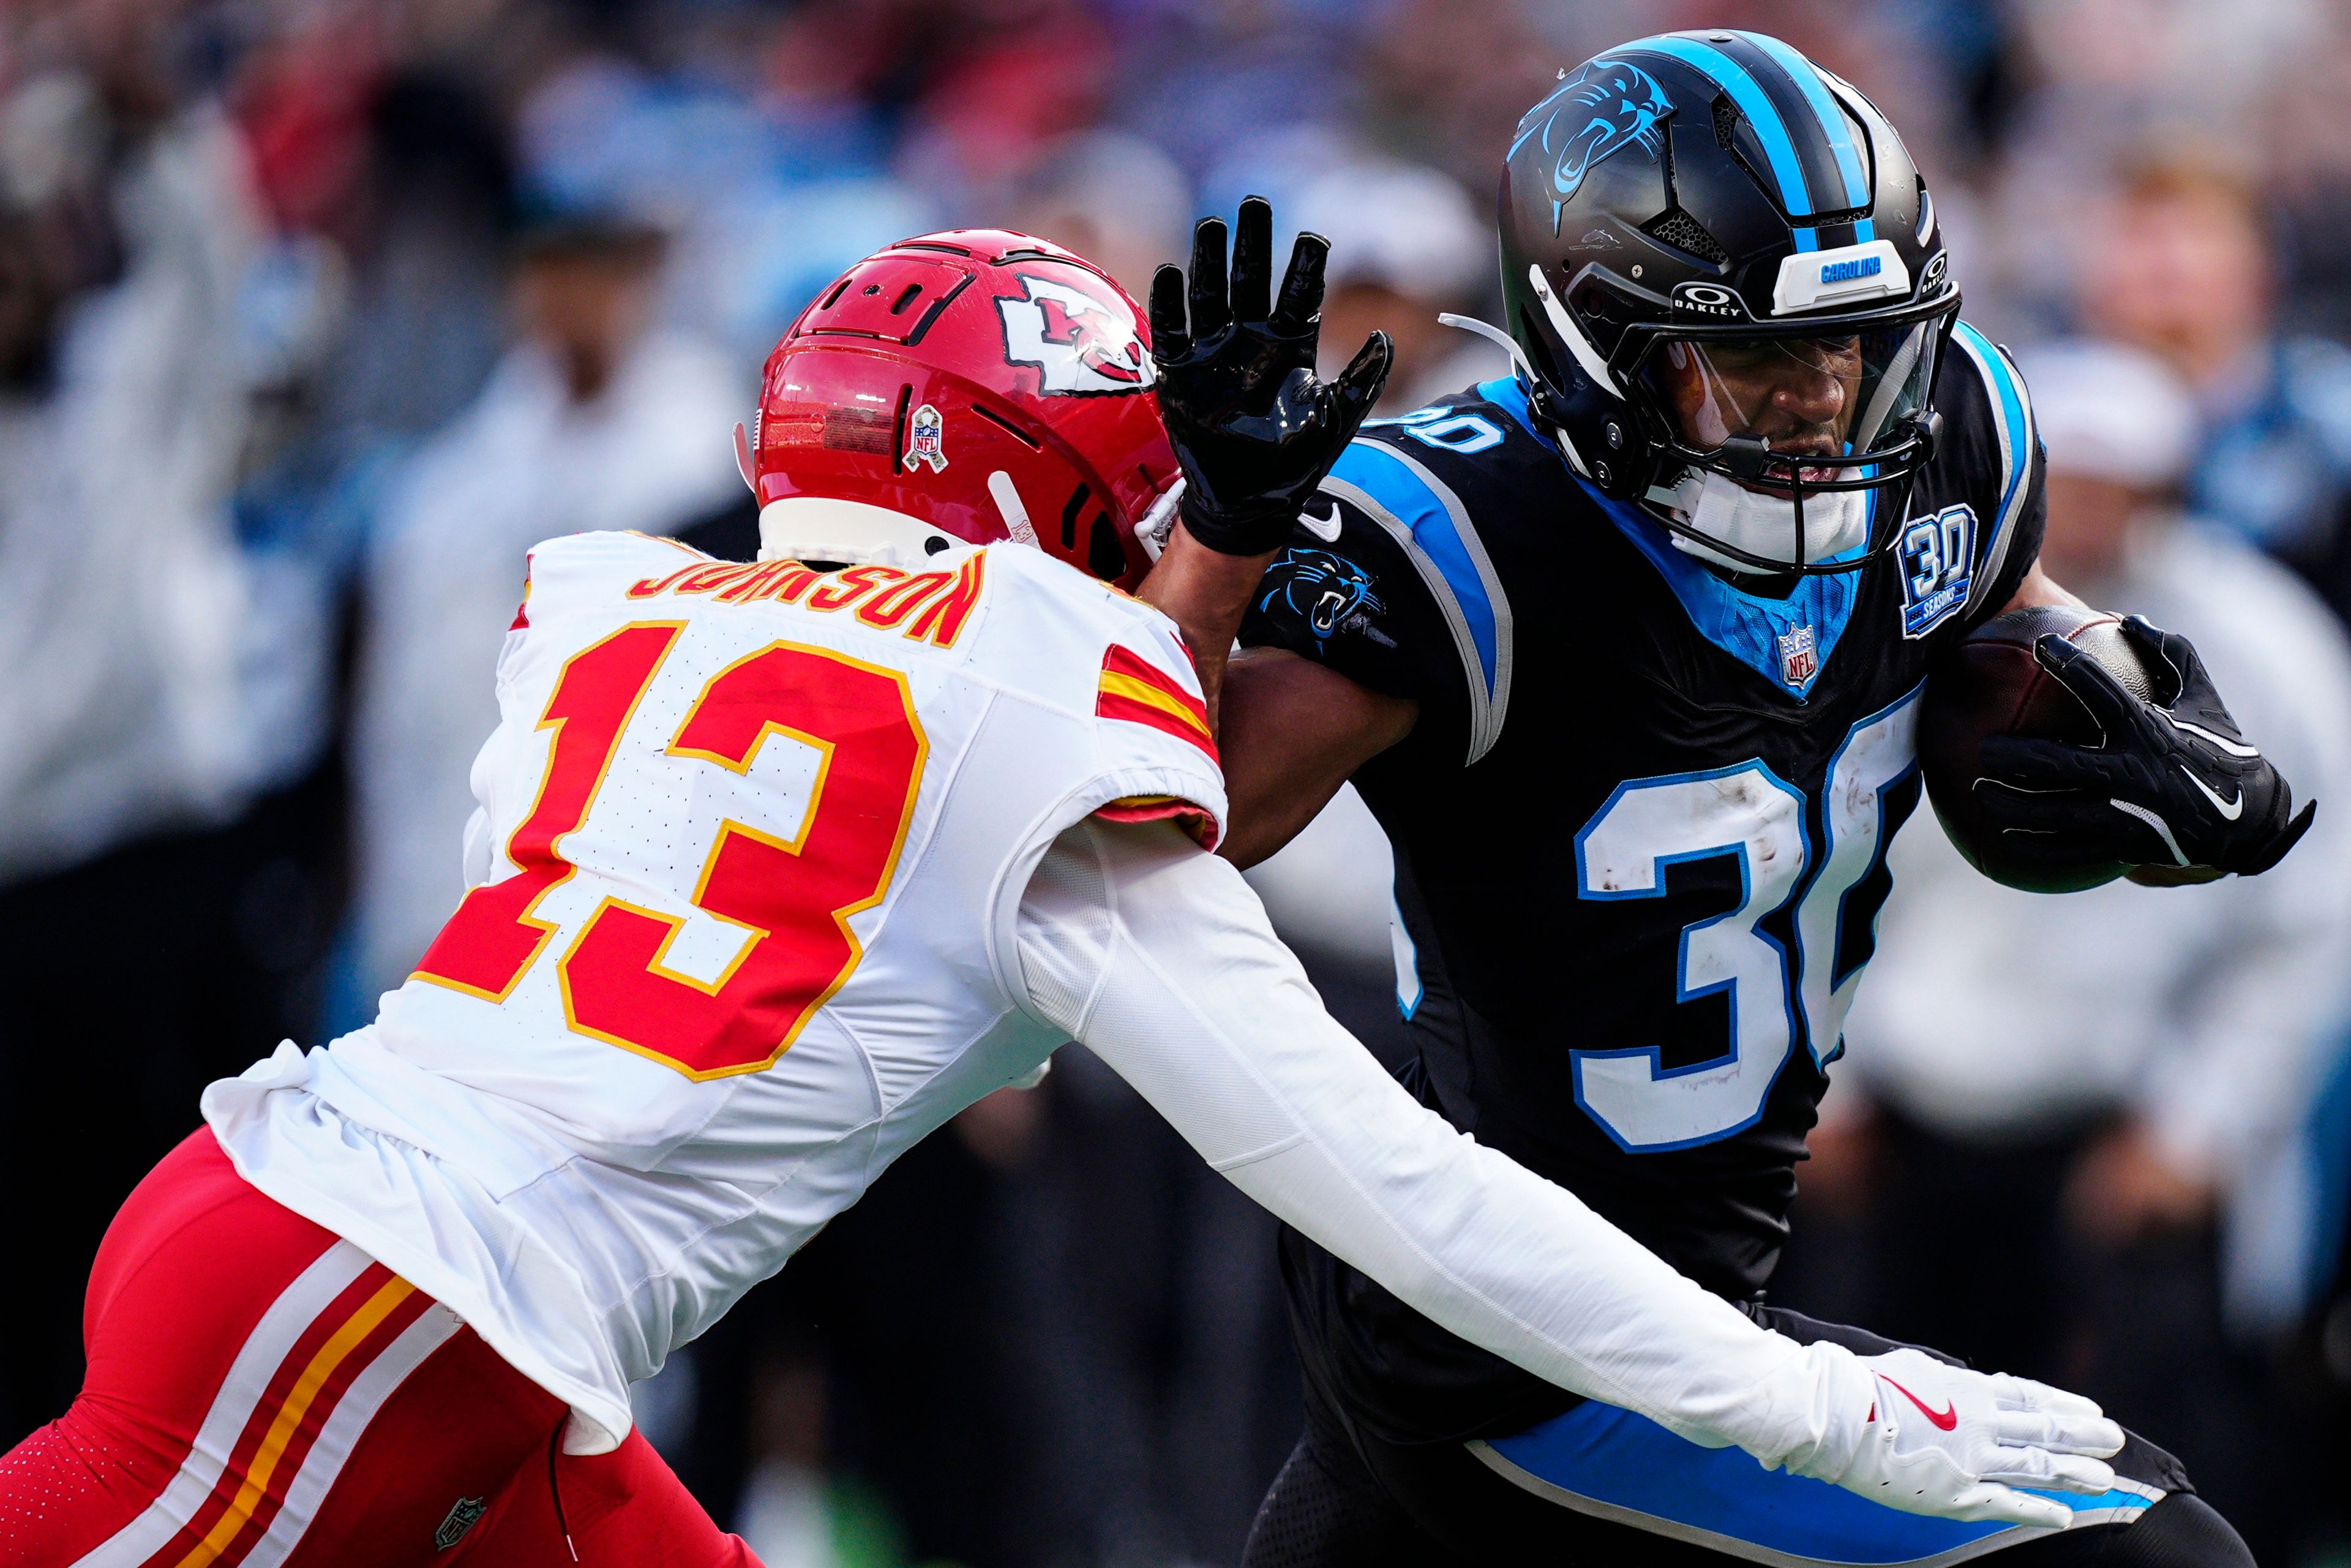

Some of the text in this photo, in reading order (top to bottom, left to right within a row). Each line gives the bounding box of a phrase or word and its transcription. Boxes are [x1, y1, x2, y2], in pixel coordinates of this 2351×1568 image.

[1821, 256, 1881, 283] CAROLINA
[1675, 299, 1739, 316] OAKLEY
[917, 437, 936, 452] NFL
[1011, 519, 1034, 544] 13
[1904, 509, 1970, 599] 30
[625, 549, 988, 649] JOHNSON
[1923, 586, 1956, 619] SEASONS
[1788, 651, 1813, 678] NFL
[405, 620, 930, 1083] 13
